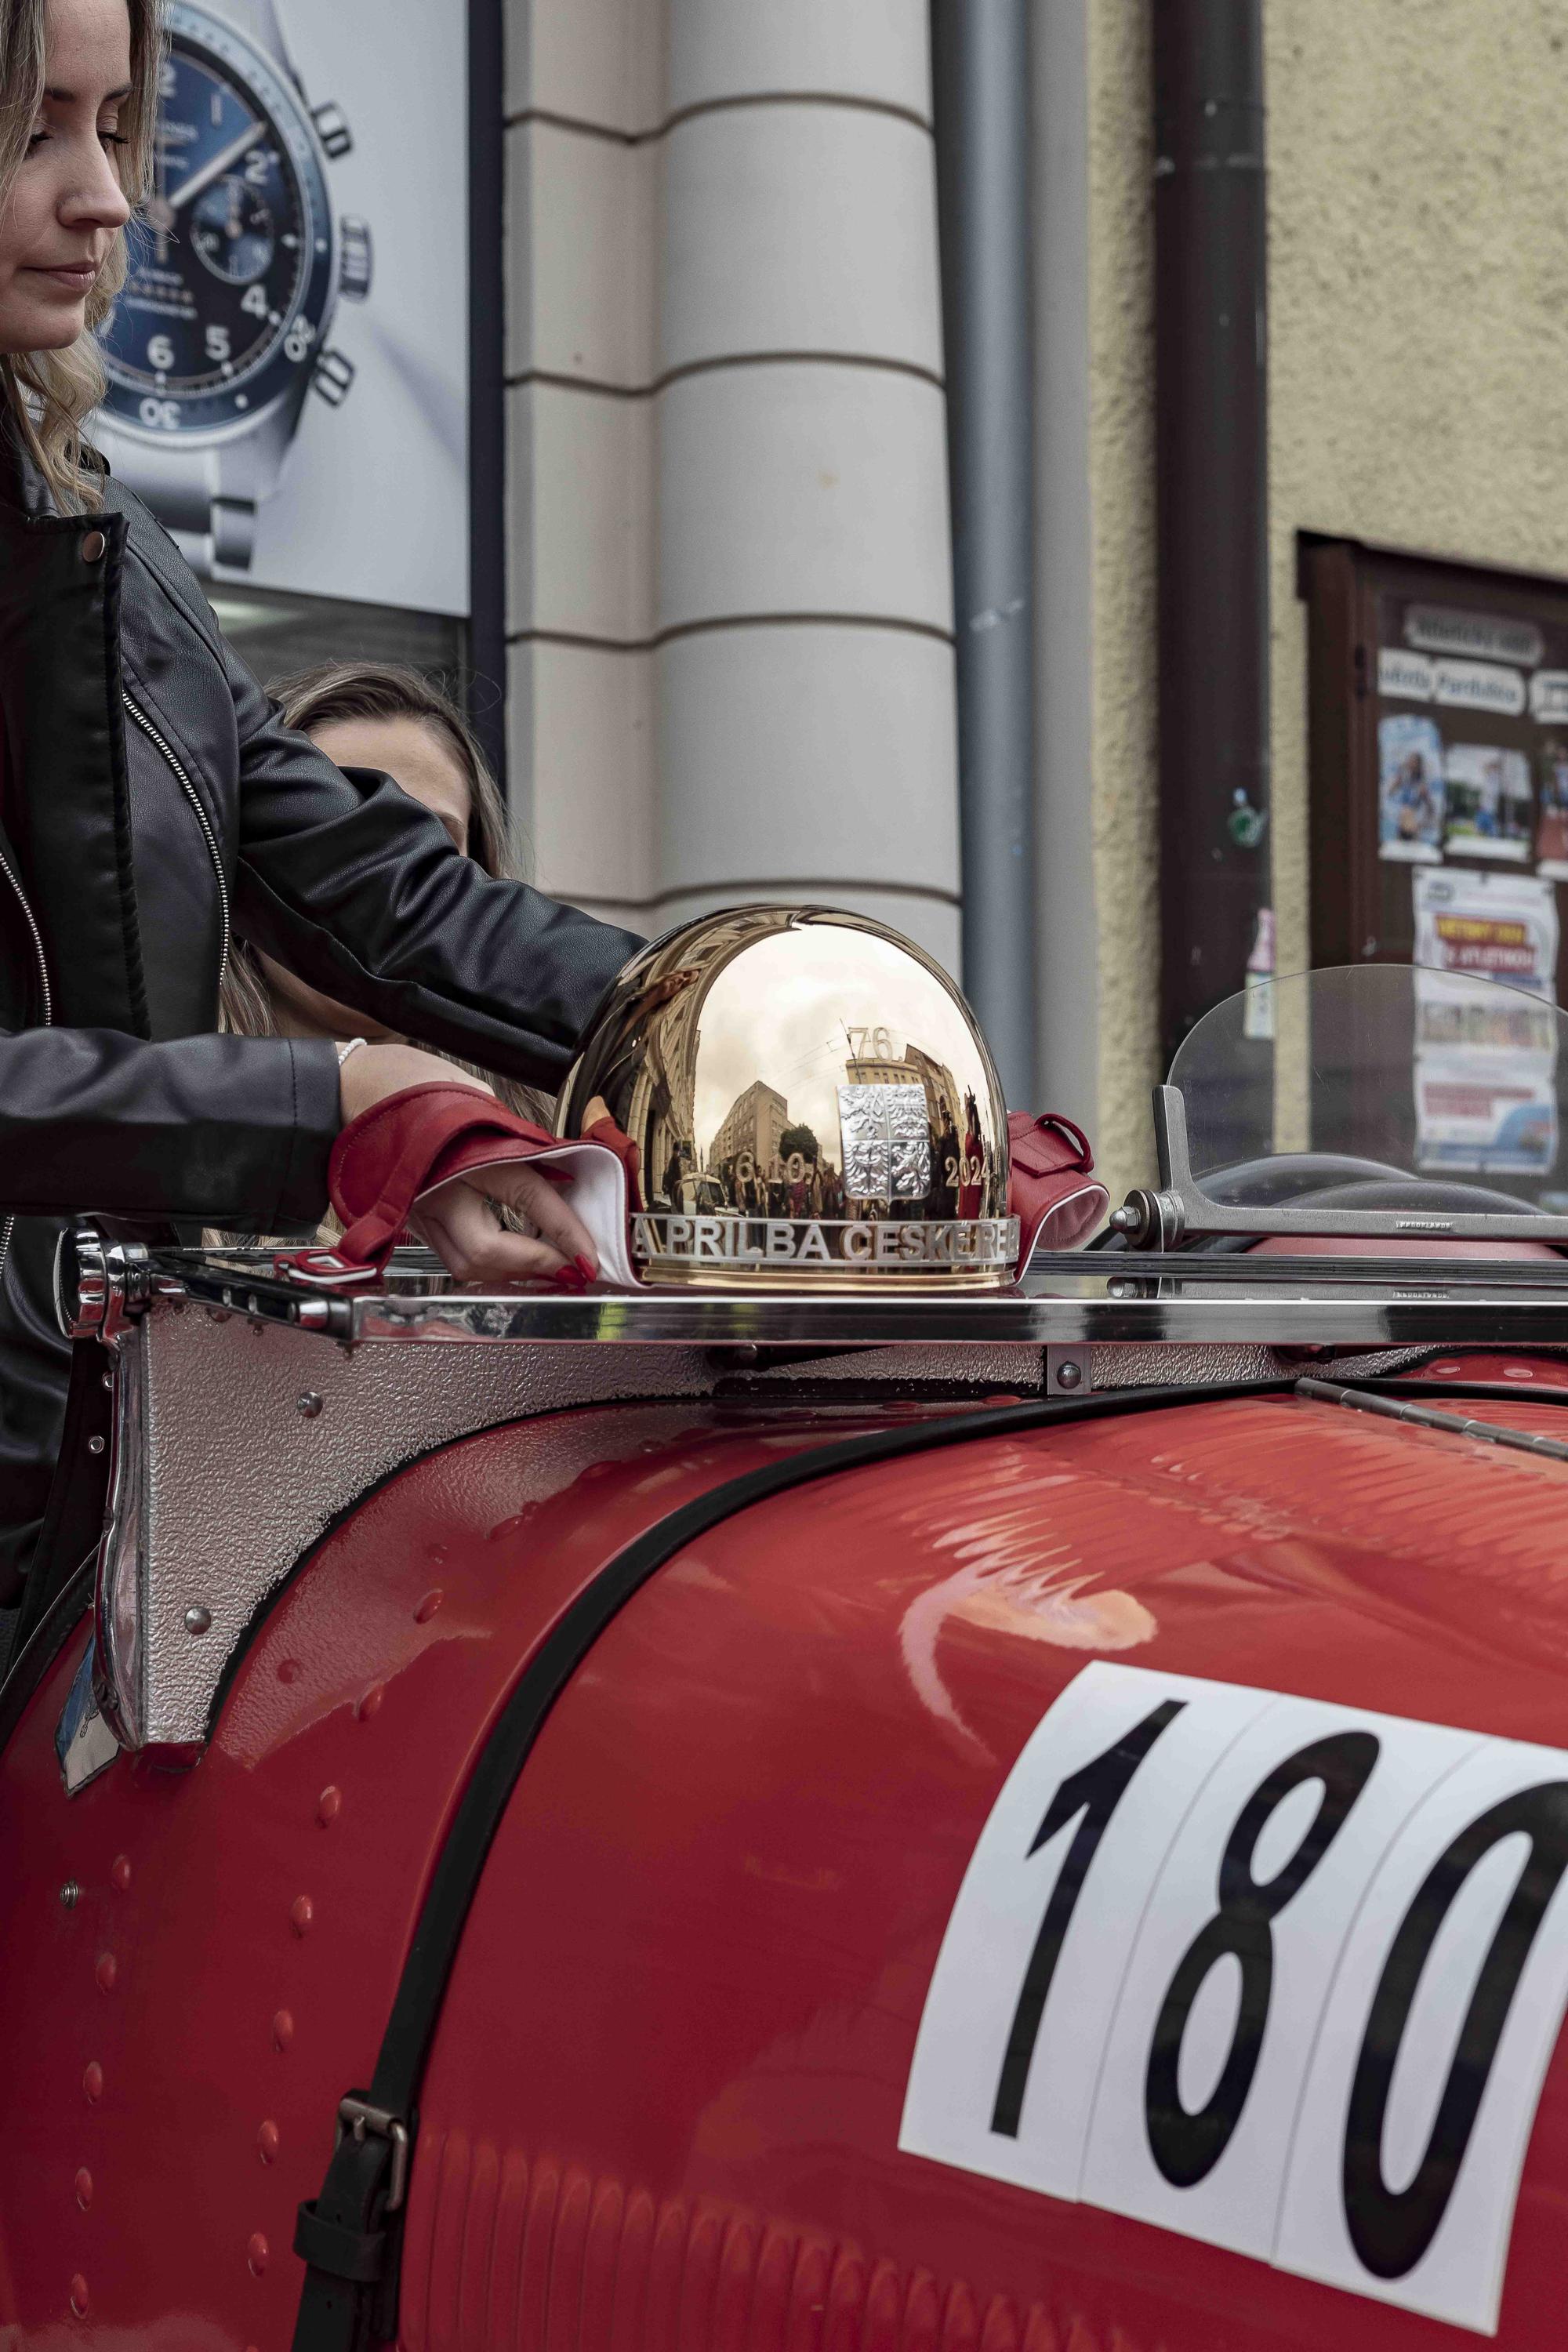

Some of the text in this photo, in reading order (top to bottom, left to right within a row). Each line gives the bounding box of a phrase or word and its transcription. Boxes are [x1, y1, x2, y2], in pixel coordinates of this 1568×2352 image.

[244, 149, 270, 185] 2
[240, 284, 268, 319] 4
[147, 335, 175, 370] 6
[205, 325, 230, 361] 5
[945, 1156, 991, 1187] 2024
[990, 1700, 1568, 2280] 180
